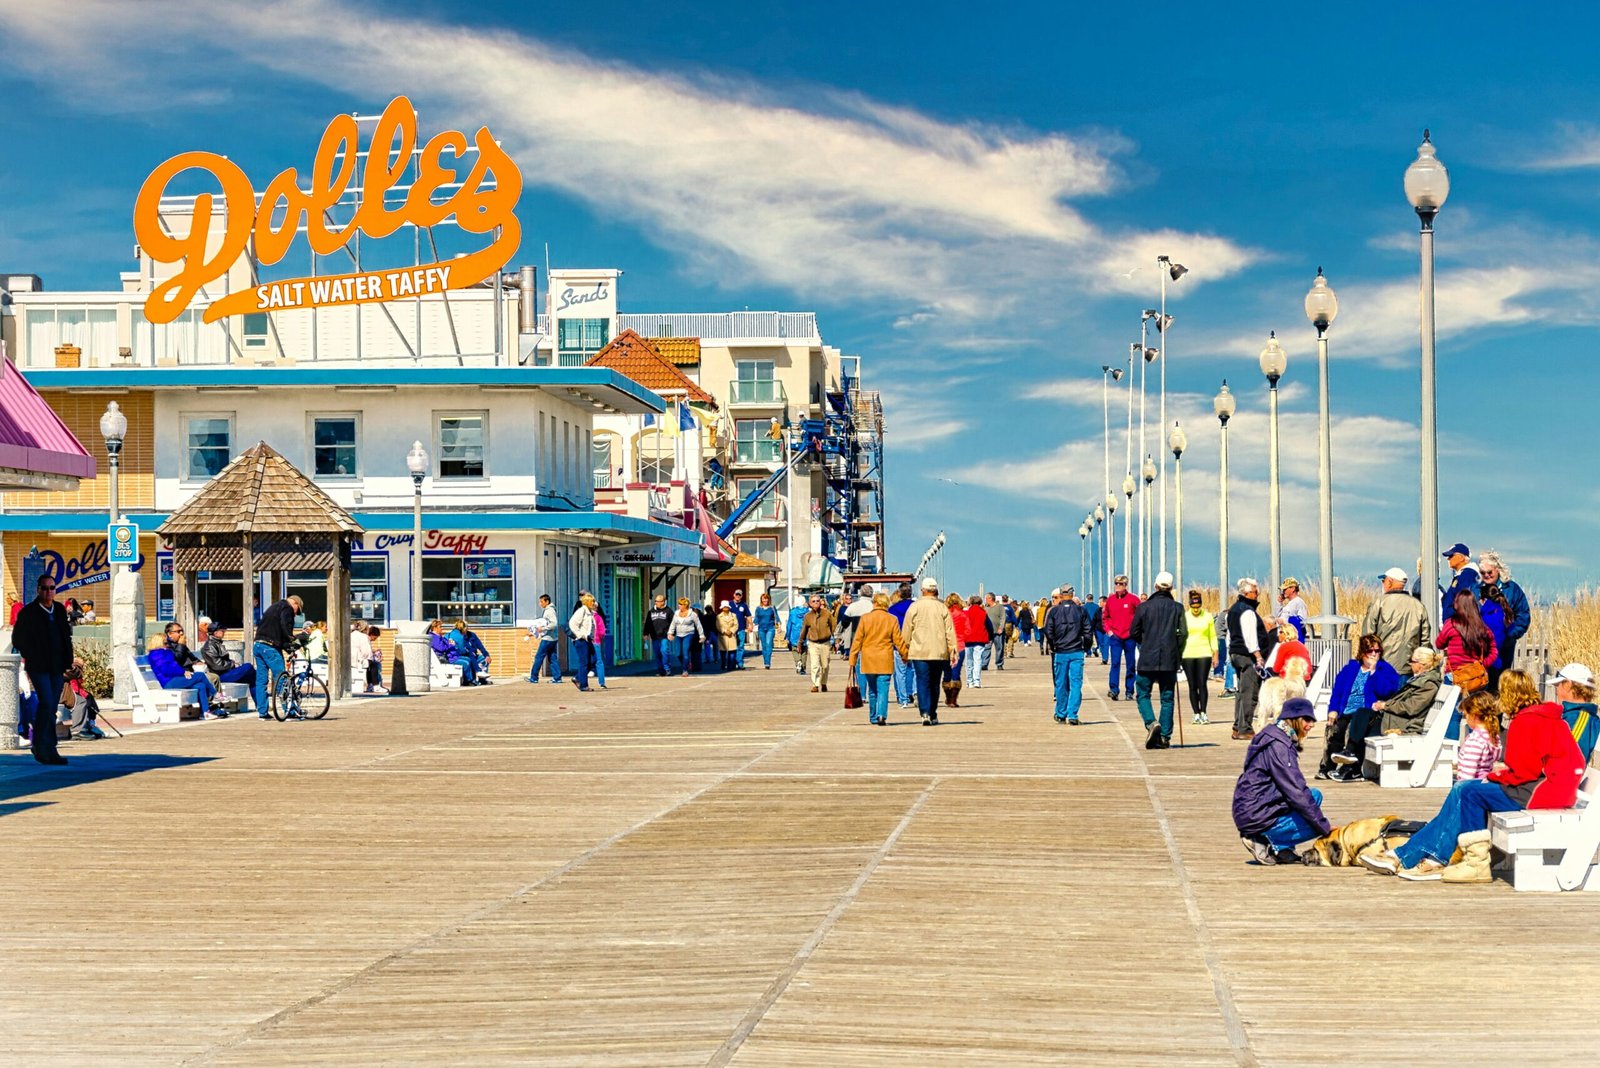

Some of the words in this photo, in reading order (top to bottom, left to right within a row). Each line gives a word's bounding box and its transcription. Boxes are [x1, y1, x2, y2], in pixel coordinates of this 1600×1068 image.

[133, 95, 523, 324] Dolles
[257, 283, 305, 309] SALT
[309, 275, 384, 304] WATER
[386, 265, 451, 297] TAFFY
[557, 282, 609, 311] Sands
[115, 549, 132, 558] STOP
[424, 530, 489, 556] Taffy
[68, 580, 84, 589] SALT
[84, 573, 108, 585] WATER
